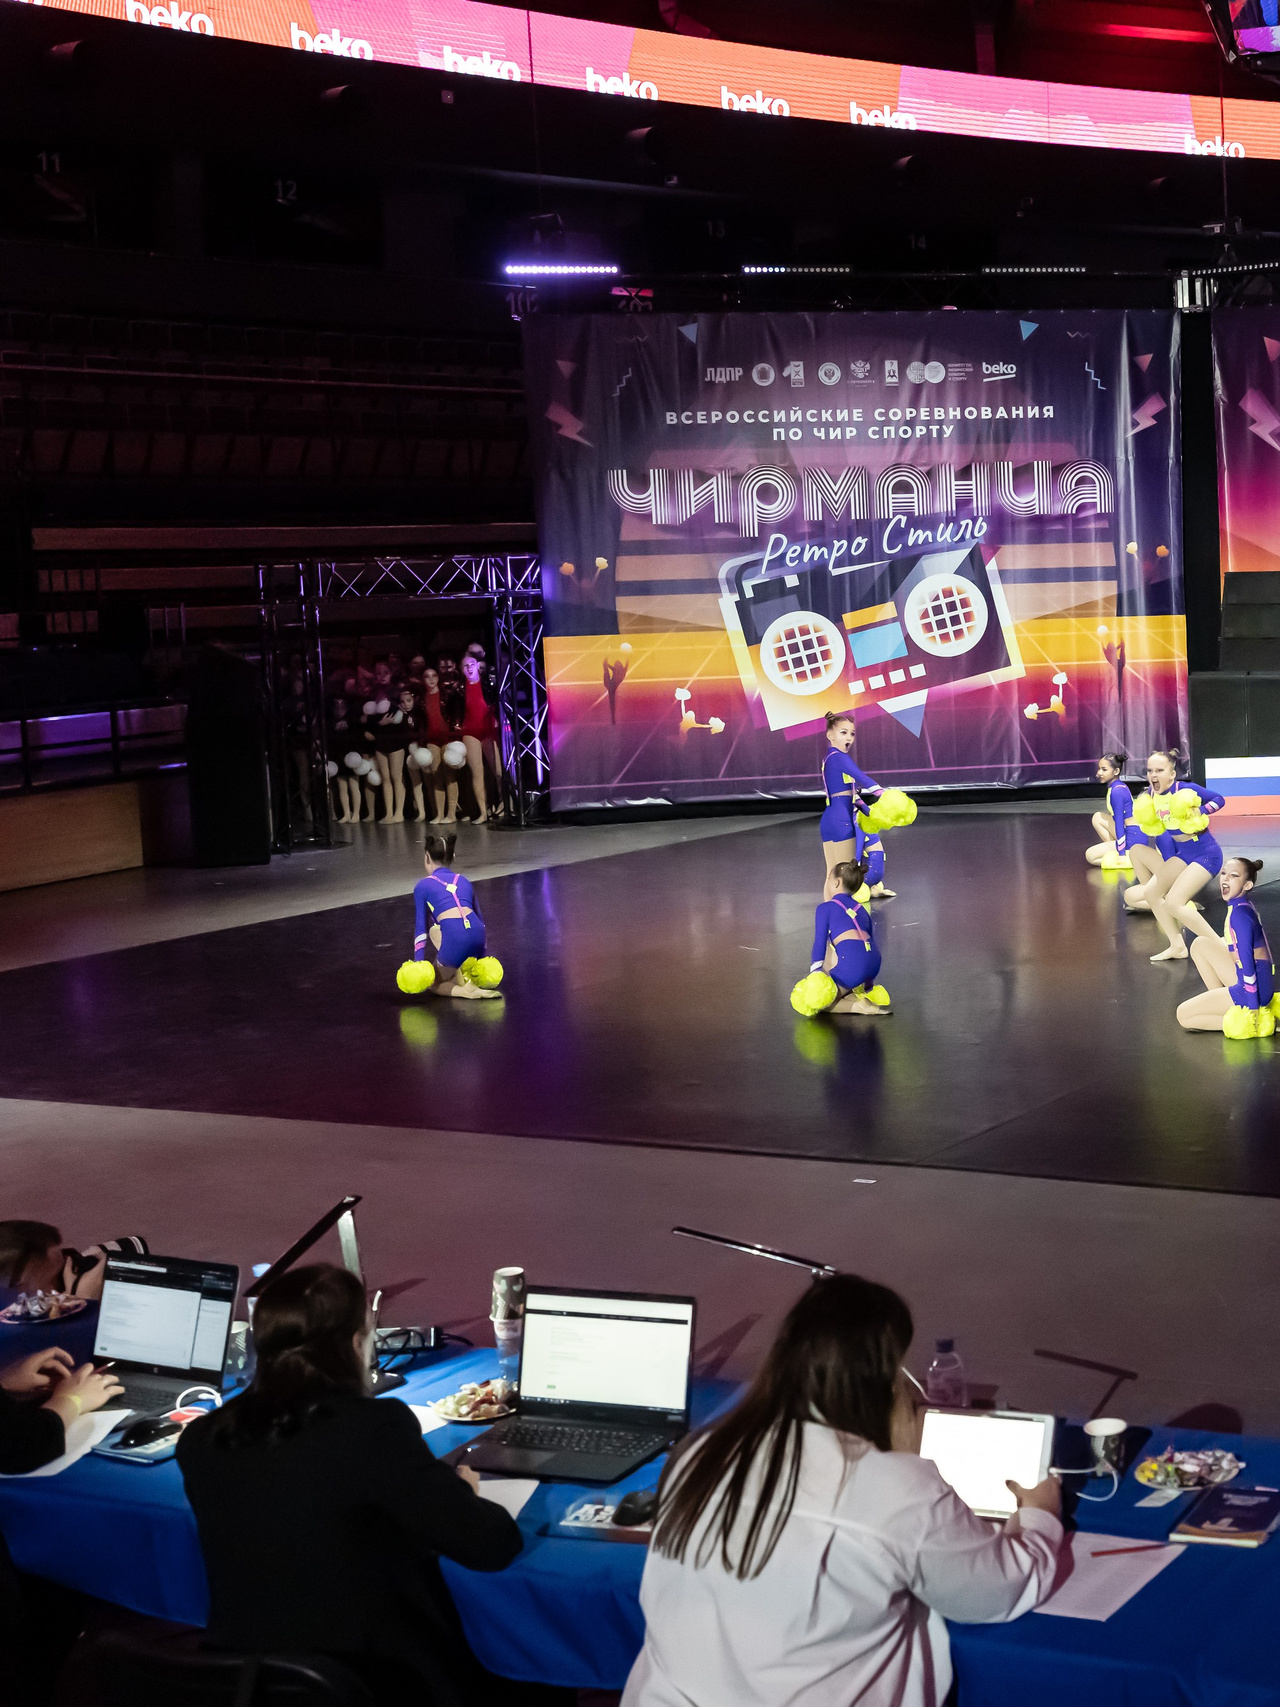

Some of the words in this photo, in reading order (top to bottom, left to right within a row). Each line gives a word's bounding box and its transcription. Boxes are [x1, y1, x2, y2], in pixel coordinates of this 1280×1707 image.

[126, 0, 214, 35] beko
[290, 22, 374, 60] beko
[443, 45, 521, 81] beko
[586, 67, 659, 100] beko
[721, 86, 790, 117] beko
[849, 101, 917, 130] beko
[1184, 134, 1246, 158] beko
[274, 179, 297, 201] 12
[704, 367, 744, 384] ЛДПР
[982, 361, 1017, 375] beko
[665, 406, 864, 425] ВСЕРОССИЙСКИЕ
[873, 405, 1055, 421] СОРЕВНОВАНИЯ
[772, 427, 803, 441] ПО
[813, 427, 858, 440] ЧИР
[867, 425, 955, 439] СПОРТУ
[761, 532, 869, 575] Ретро
[882, 513, 989, 555] Стиль
